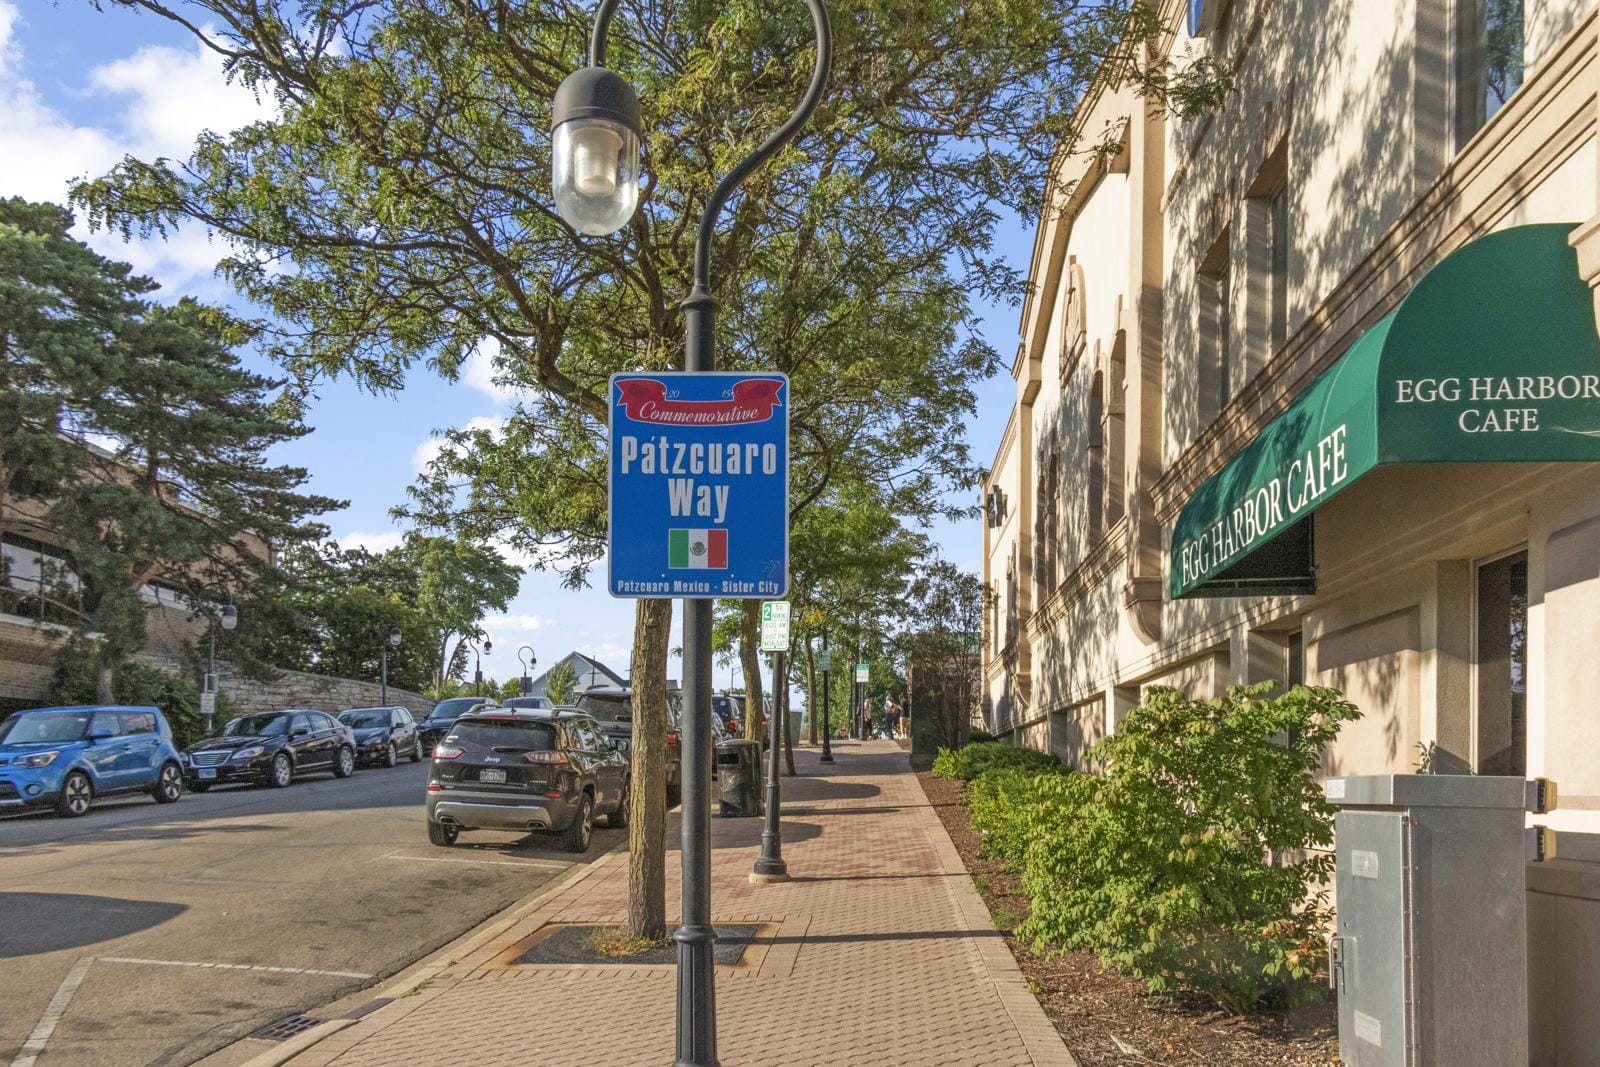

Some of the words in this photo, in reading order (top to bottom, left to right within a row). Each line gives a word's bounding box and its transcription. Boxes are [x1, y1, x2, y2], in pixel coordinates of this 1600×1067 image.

[667, 389, 680, 399] 20
[1395, 378, 1462, 403] EGG
[1469, 375, 1600, 401] HARBOR
[639, 401, 759, 423] Commemorative
[1458, 408, 1540, 433] CAFE
[621, 435, 777, 475] Pátzcuaro
[668, 478, 729, 524] Way
[1182, 533, 1208, 587] EGG
[1211, 478, 1283, 568] HARBOR
[1287, 424, 1348, 514] CAFE
[617, 580, 670, 593] Patzcuaro
[673, 580, 710, 593] Mexico
[722, 580, 754, 593] Sister
[758, 580, 779, 595] City
[764, 606, 771, 619] 2
